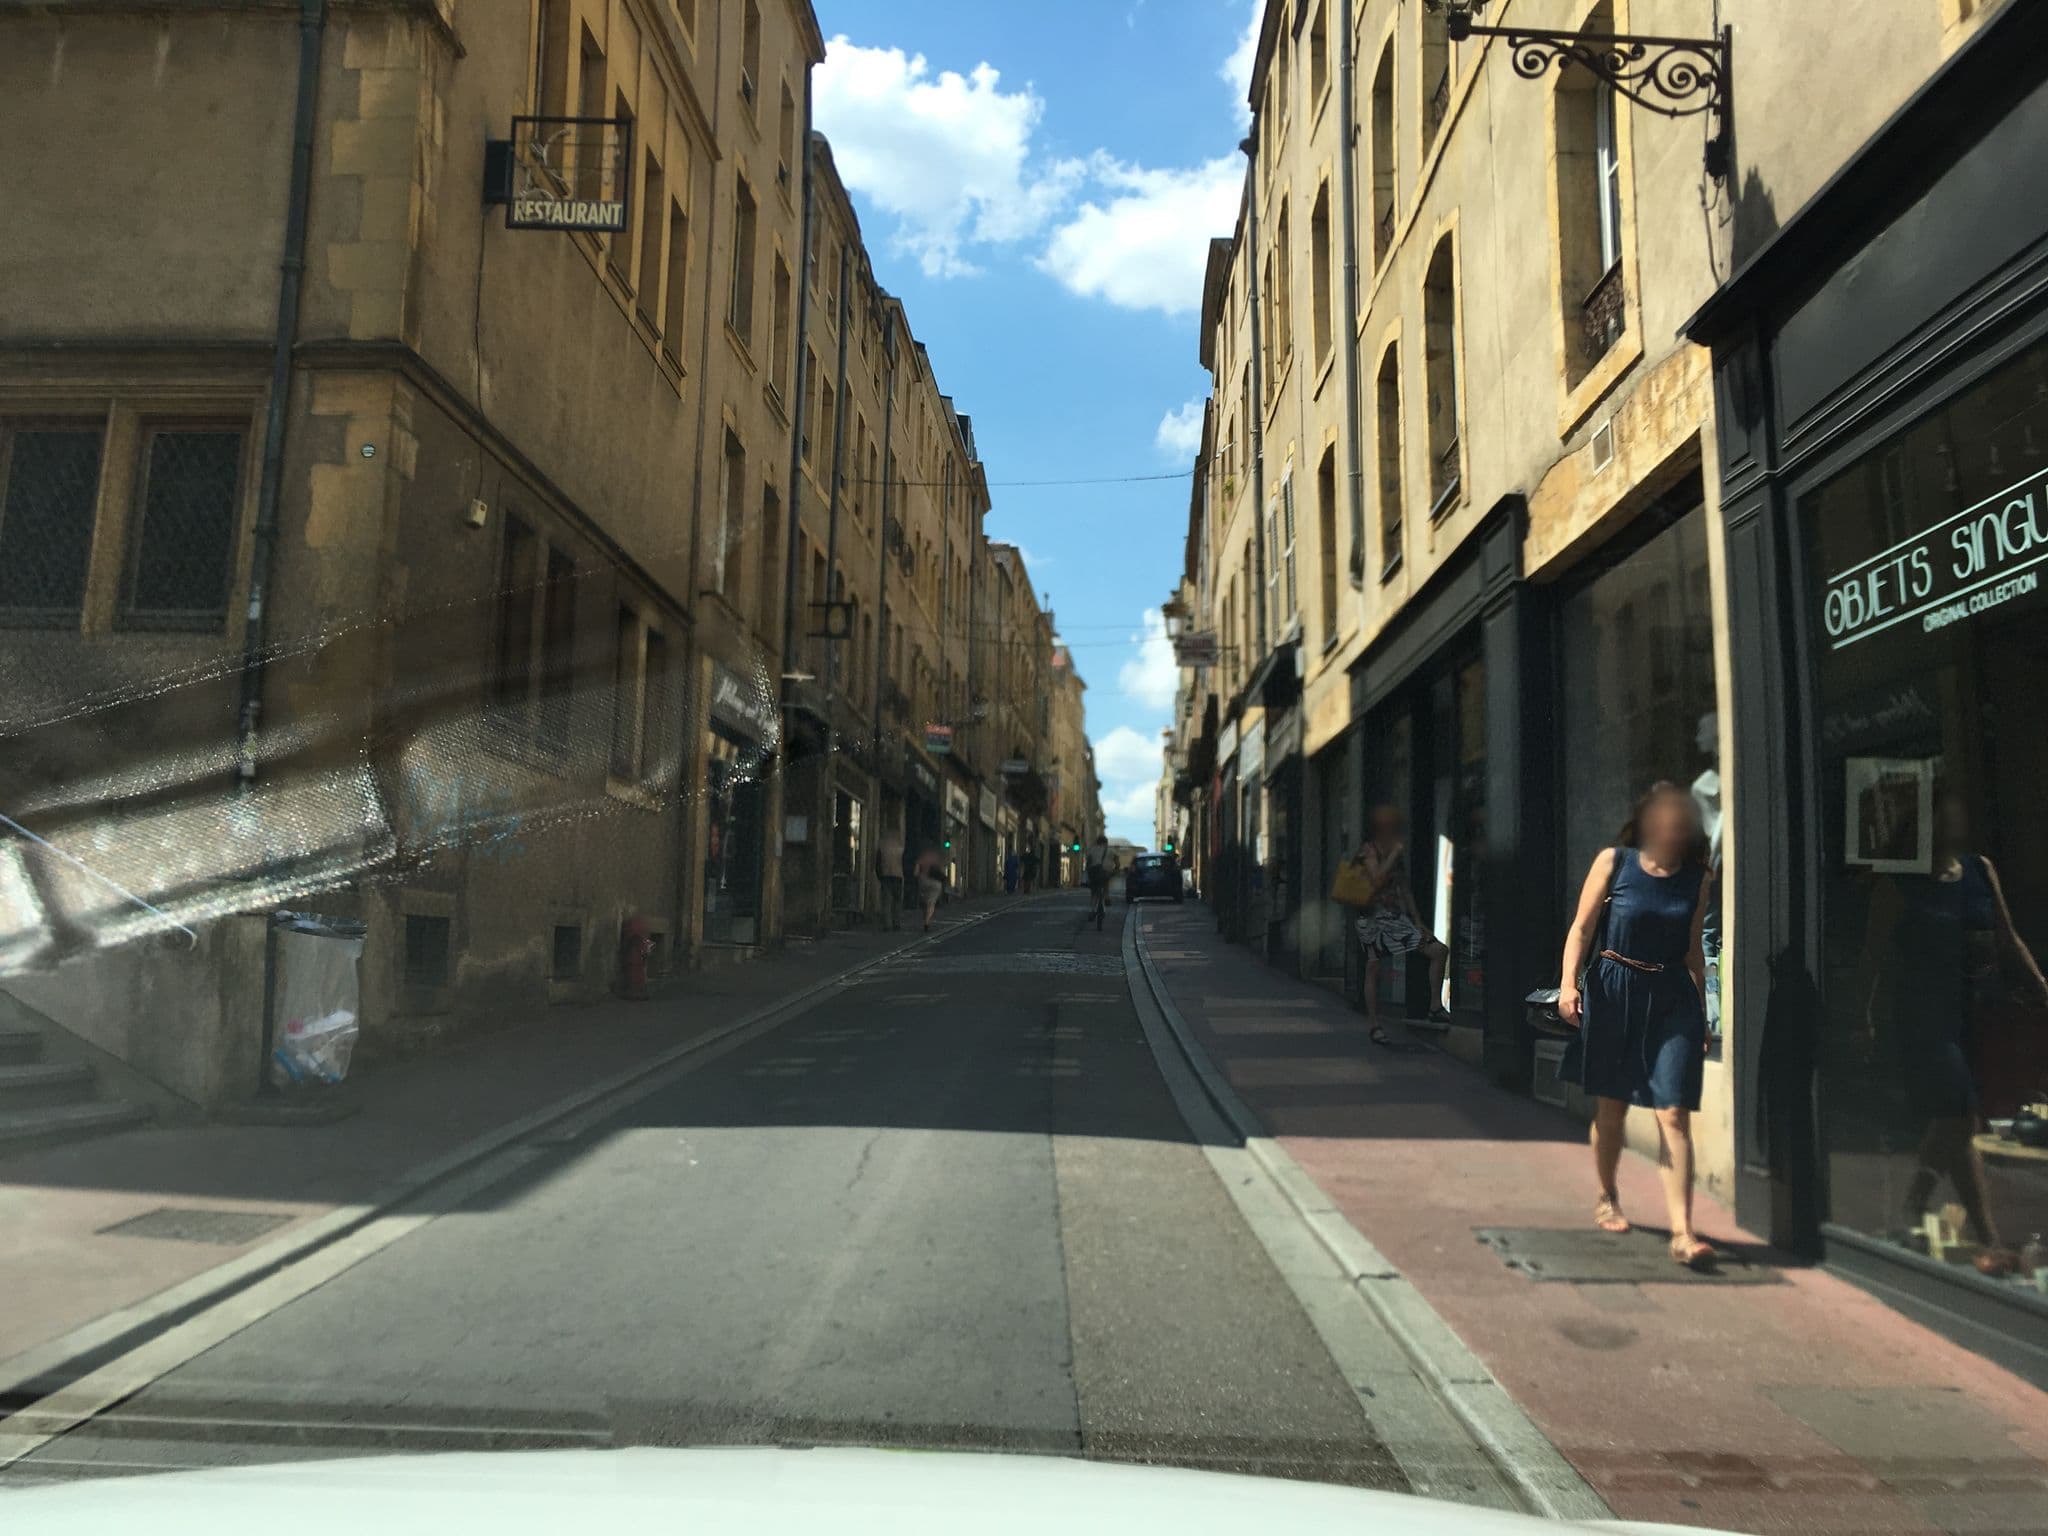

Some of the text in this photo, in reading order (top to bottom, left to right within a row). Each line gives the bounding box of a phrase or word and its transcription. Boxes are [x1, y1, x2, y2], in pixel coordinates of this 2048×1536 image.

[514, 201, 622, 226] RESTAURANT
[1824, 546, 1933, 636] OBJETS
[1922, 572, 2038, 633] ORIGINAL COLLECTION
